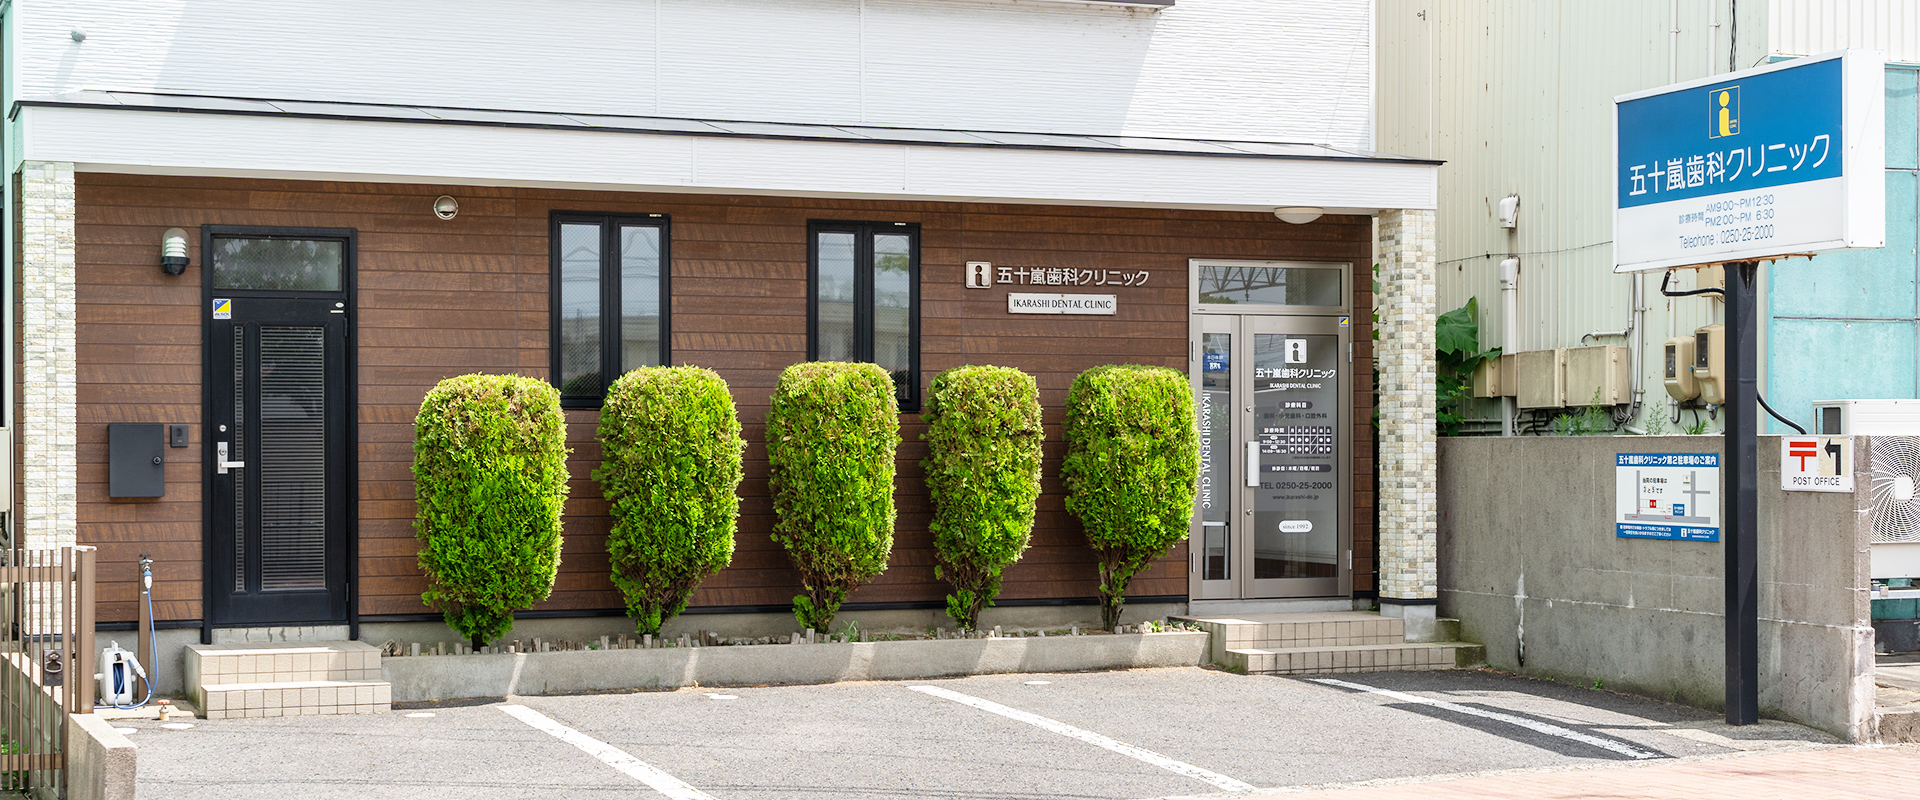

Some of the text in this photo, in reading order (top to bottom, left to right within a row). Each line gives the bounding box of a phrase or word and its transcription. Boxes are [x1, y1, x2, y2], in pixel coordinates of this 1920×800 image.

[1629, 134, 1830, 196] 五十嵐歯科クリニック
[1705, 194, 1775, 213] AM900~PM1230
[1679, 211, 1705, 224] 診療時間
[1705, 208, 1775, 227] PM200~PM 630
[1720, 224, 1775, 245] 0250-25-2000
[997, 266, 1150, 286] 五十嵐歯科クリニック
[1013, 299, 1112, 309] IKARASHI DENTAL CLINIC
[1255, 368, 1336, 378] 五十嵐歯科クリニック
[1202, 393, 1211, 509] IKARASHI DENTAL CLINIC
[1260, 482, 1333, 490] TEL 0250-25-2000
[1793, 476, 1840, 486] POST OFFICE
